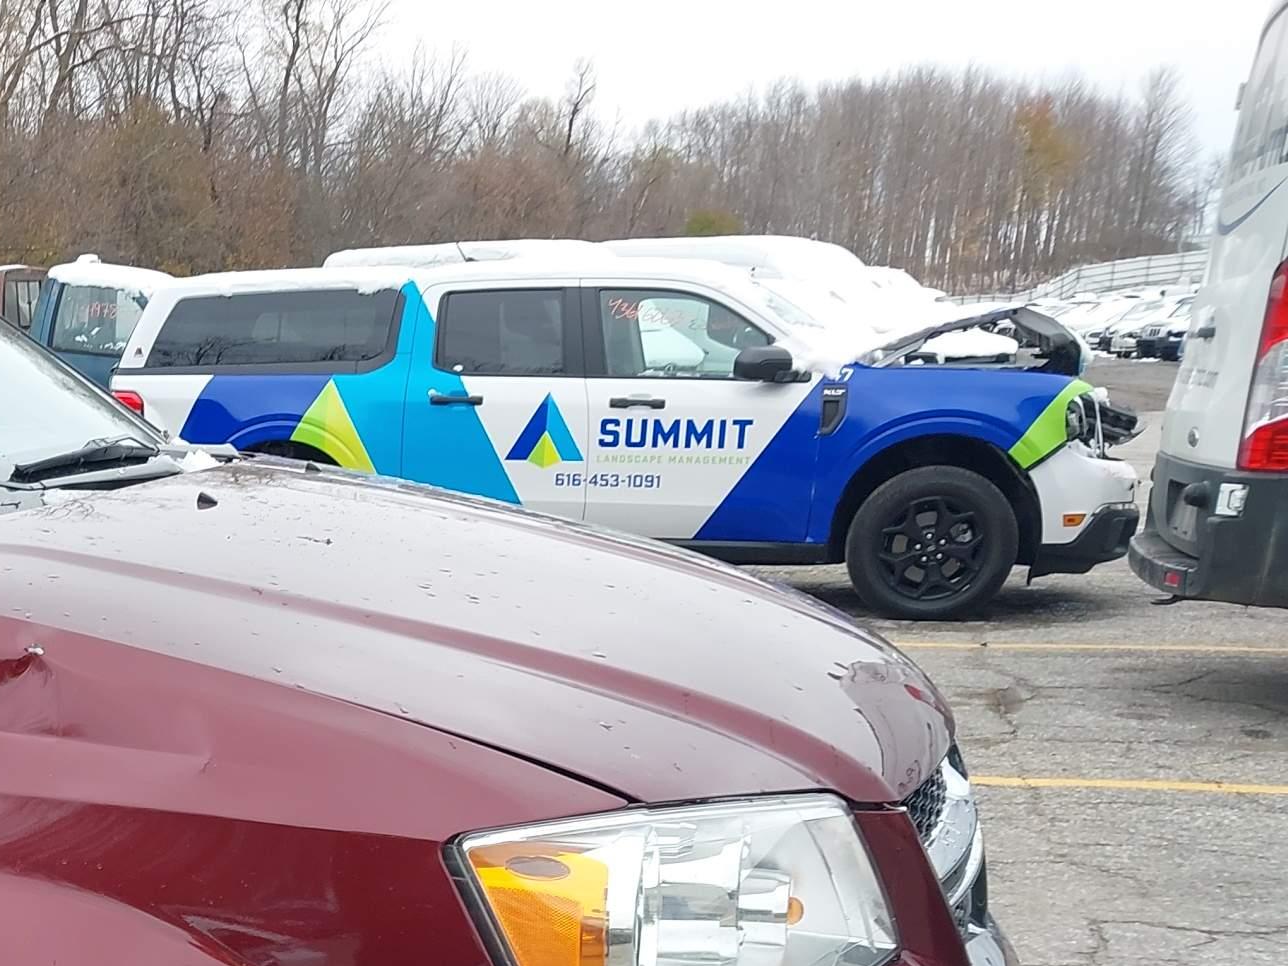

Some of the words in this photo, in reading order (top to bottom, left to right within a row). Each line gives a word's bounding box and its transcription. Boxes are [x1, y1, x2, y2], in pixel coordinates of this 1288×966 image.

[598, 418, 754, 450] SUMMIT
[596, 454, 663, 465] LANDSCAPE
[667, 455, 752, 466] MANAGEMENT
[554, 472, 662, 489] 616-453-1091
